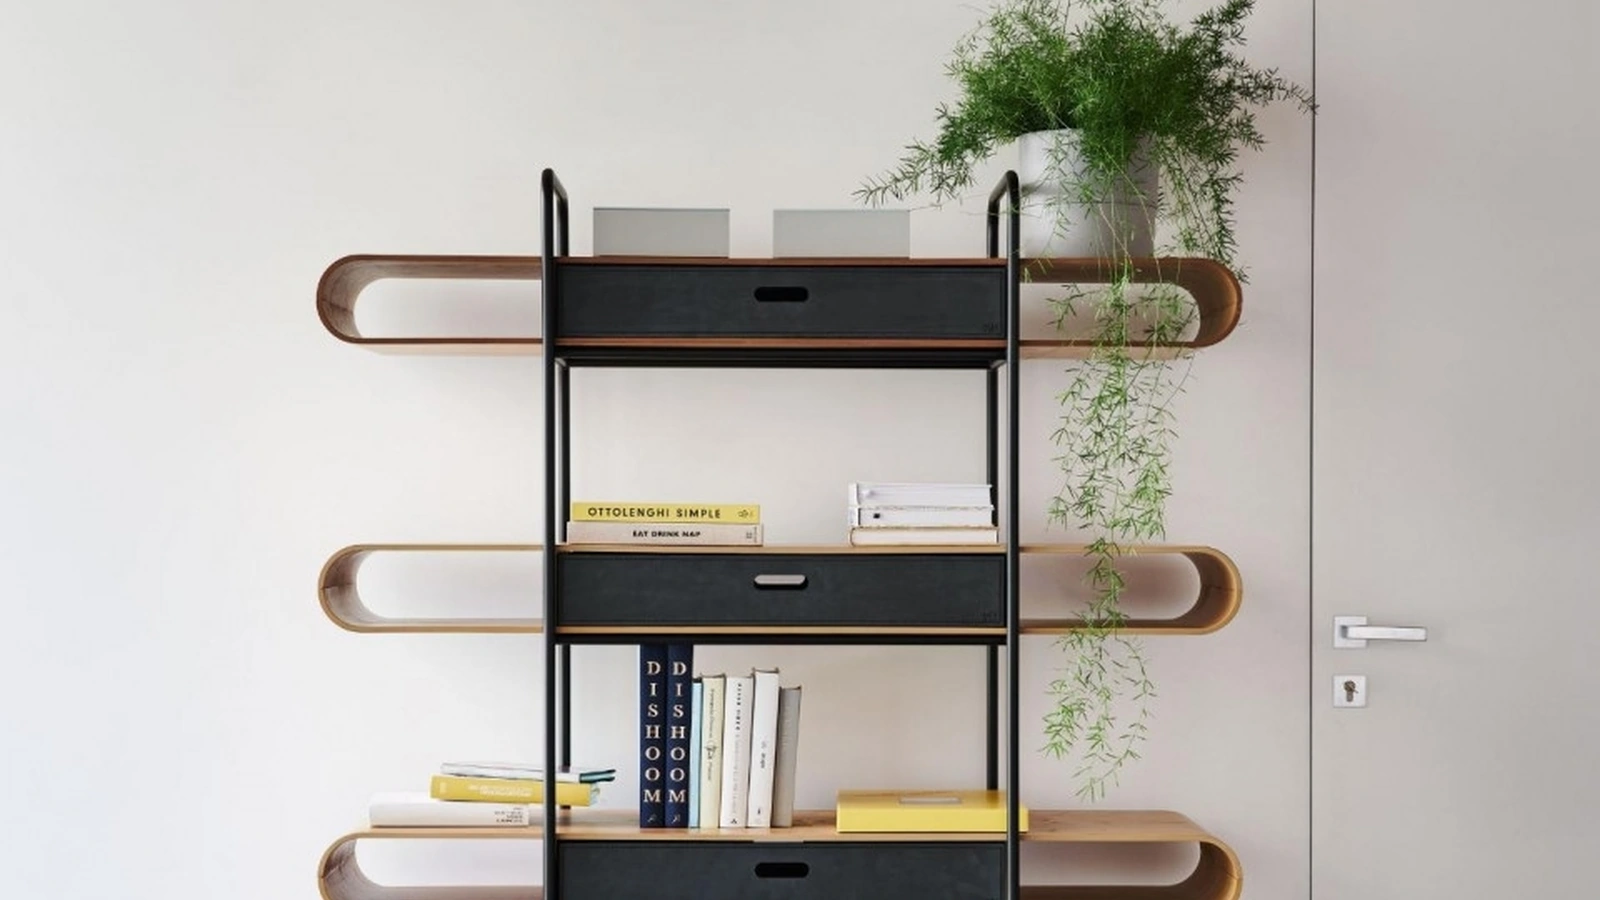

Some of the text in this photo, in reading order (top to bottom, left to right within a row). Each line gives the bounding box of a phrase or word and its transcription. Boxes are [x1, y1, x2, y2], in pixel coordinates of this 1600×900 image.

[587, 507, 721, 519] OTTOLENGHI SIMPLE
[632, 530, 701, 538] EAT DRINK NAP
[643, 660, 662, 803] DISHOOM
[668, 661, 687, 803] DISHOOM
